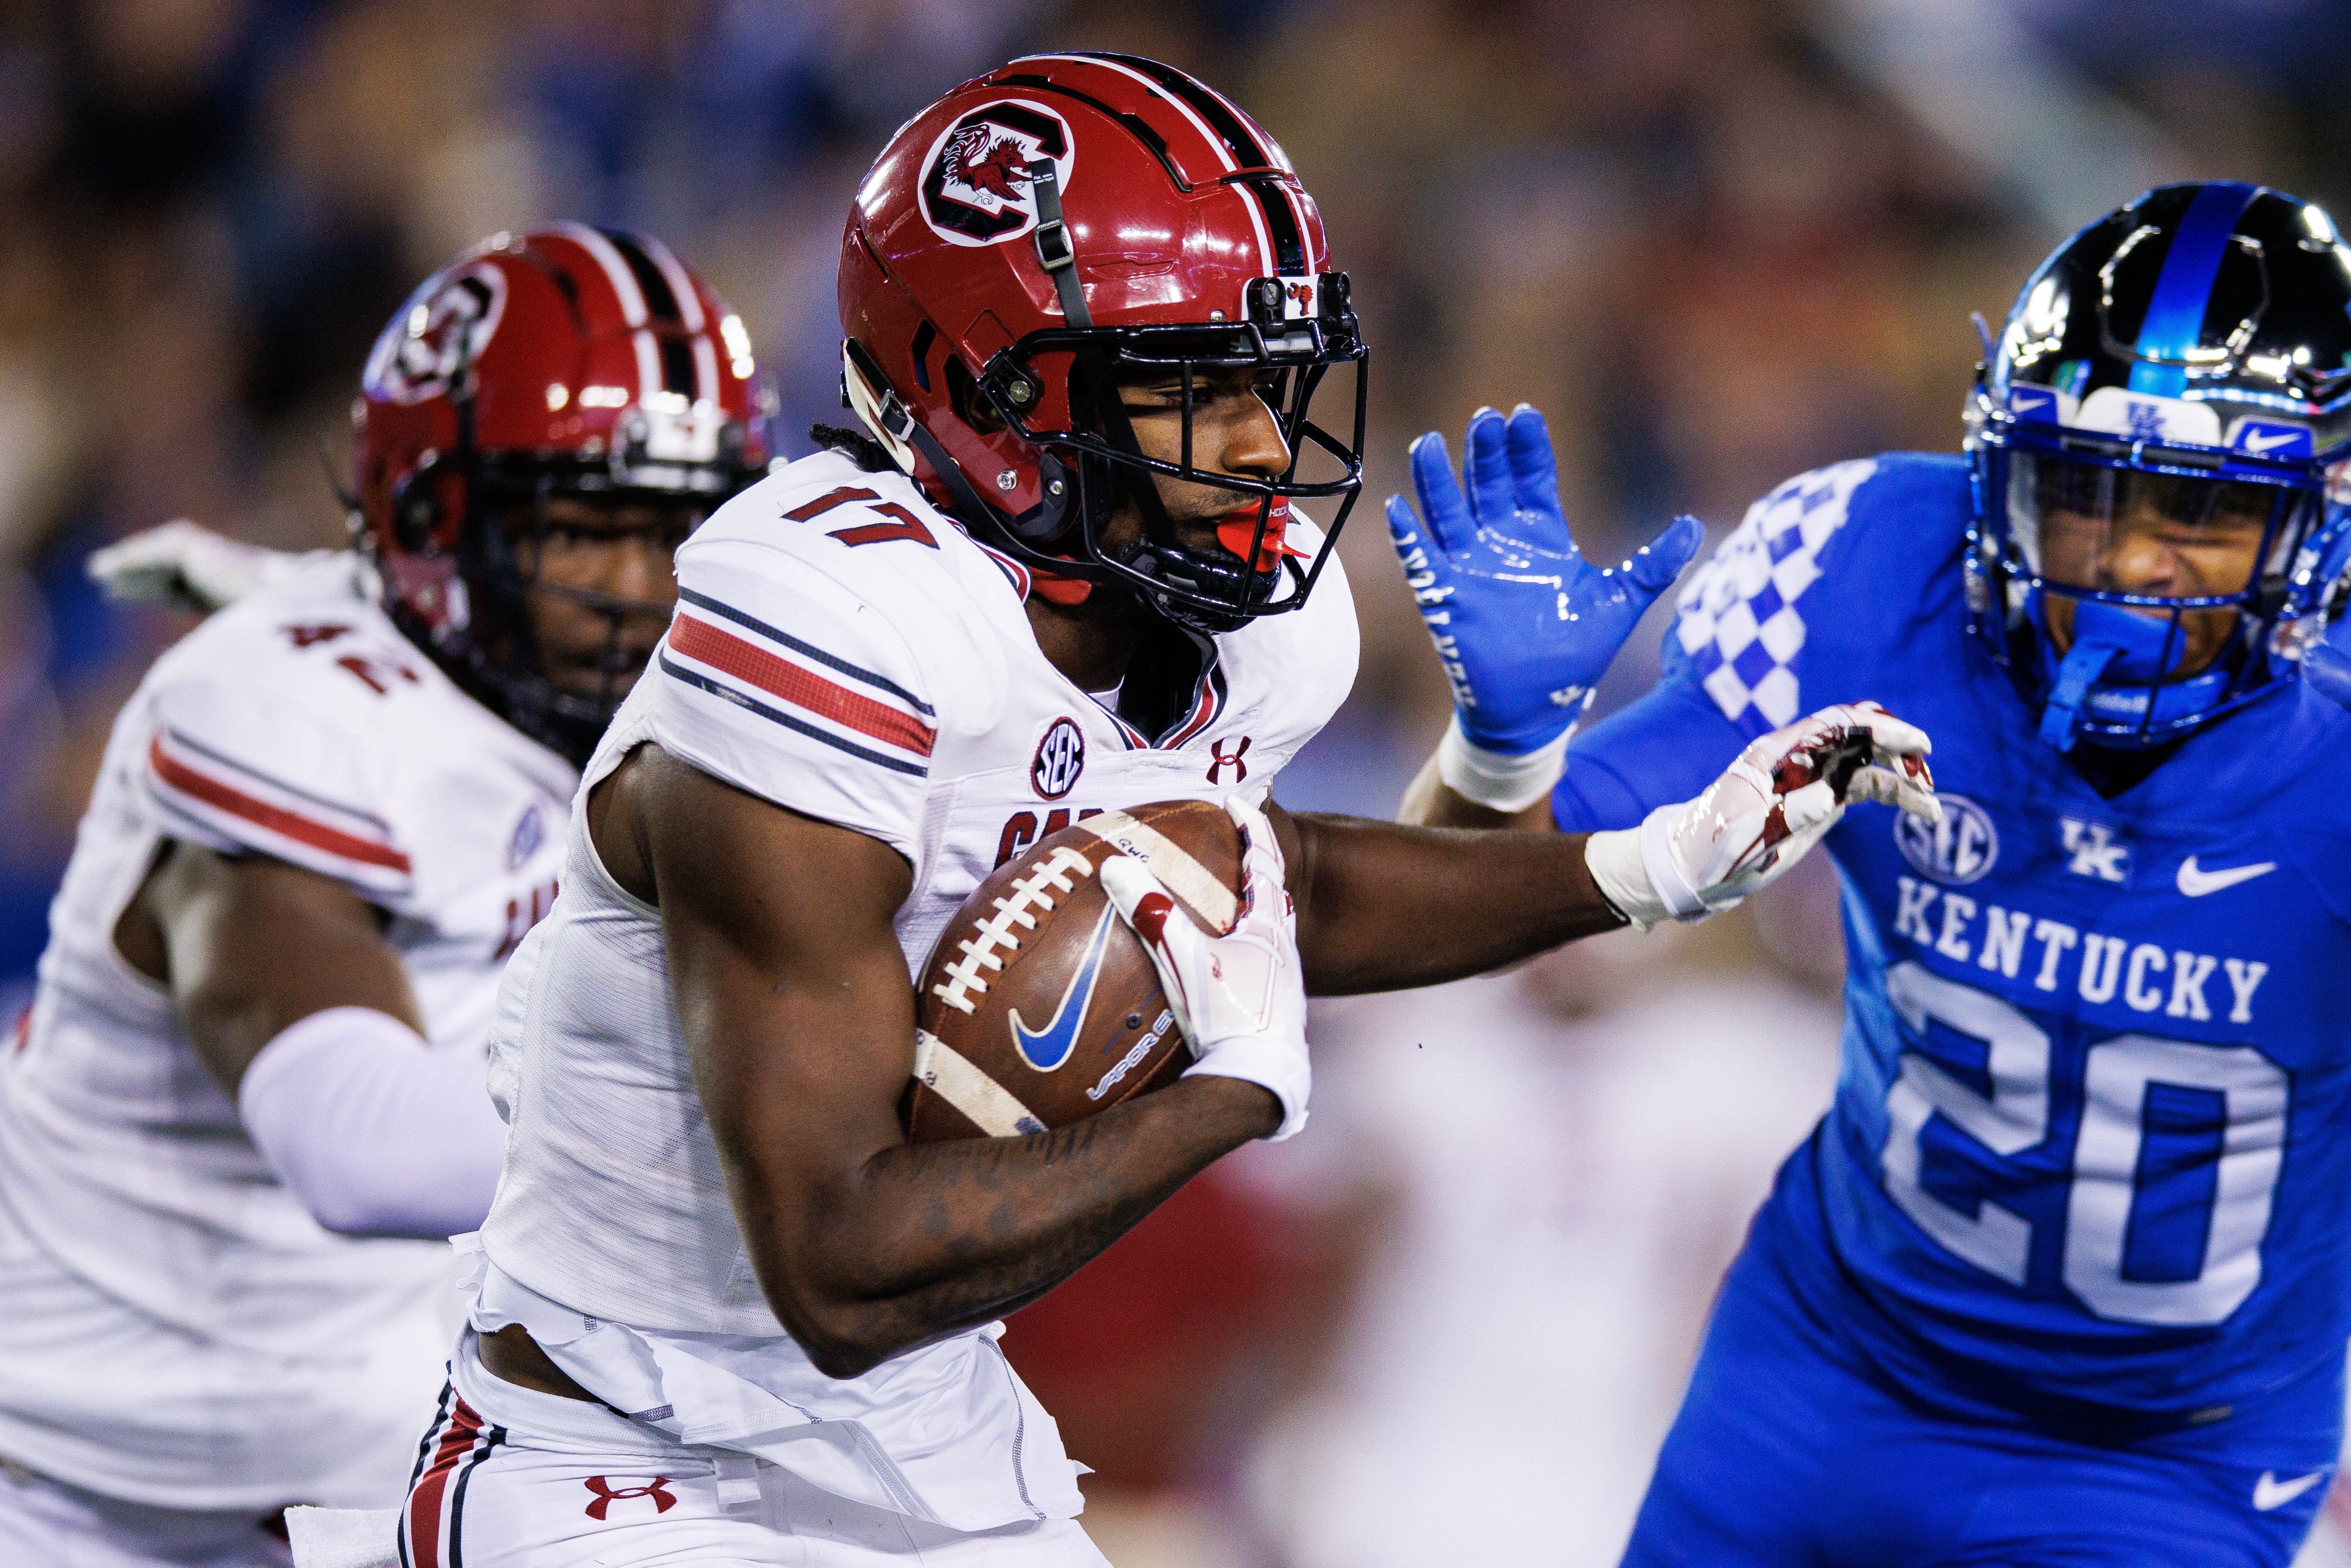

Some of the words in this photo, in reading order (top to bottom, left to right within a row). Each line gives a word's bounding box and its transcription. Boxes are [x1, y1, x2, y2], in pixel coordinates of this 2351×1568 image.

[781, 486, 941, 549] 17
[1035, 723, 1082, 795] SEC
[1893, 876, 2269, 1024] KENTUCKY
[1086, 1032, 1160, 1101] VAPOR
[1881, 959, 2292, 1328] 20
